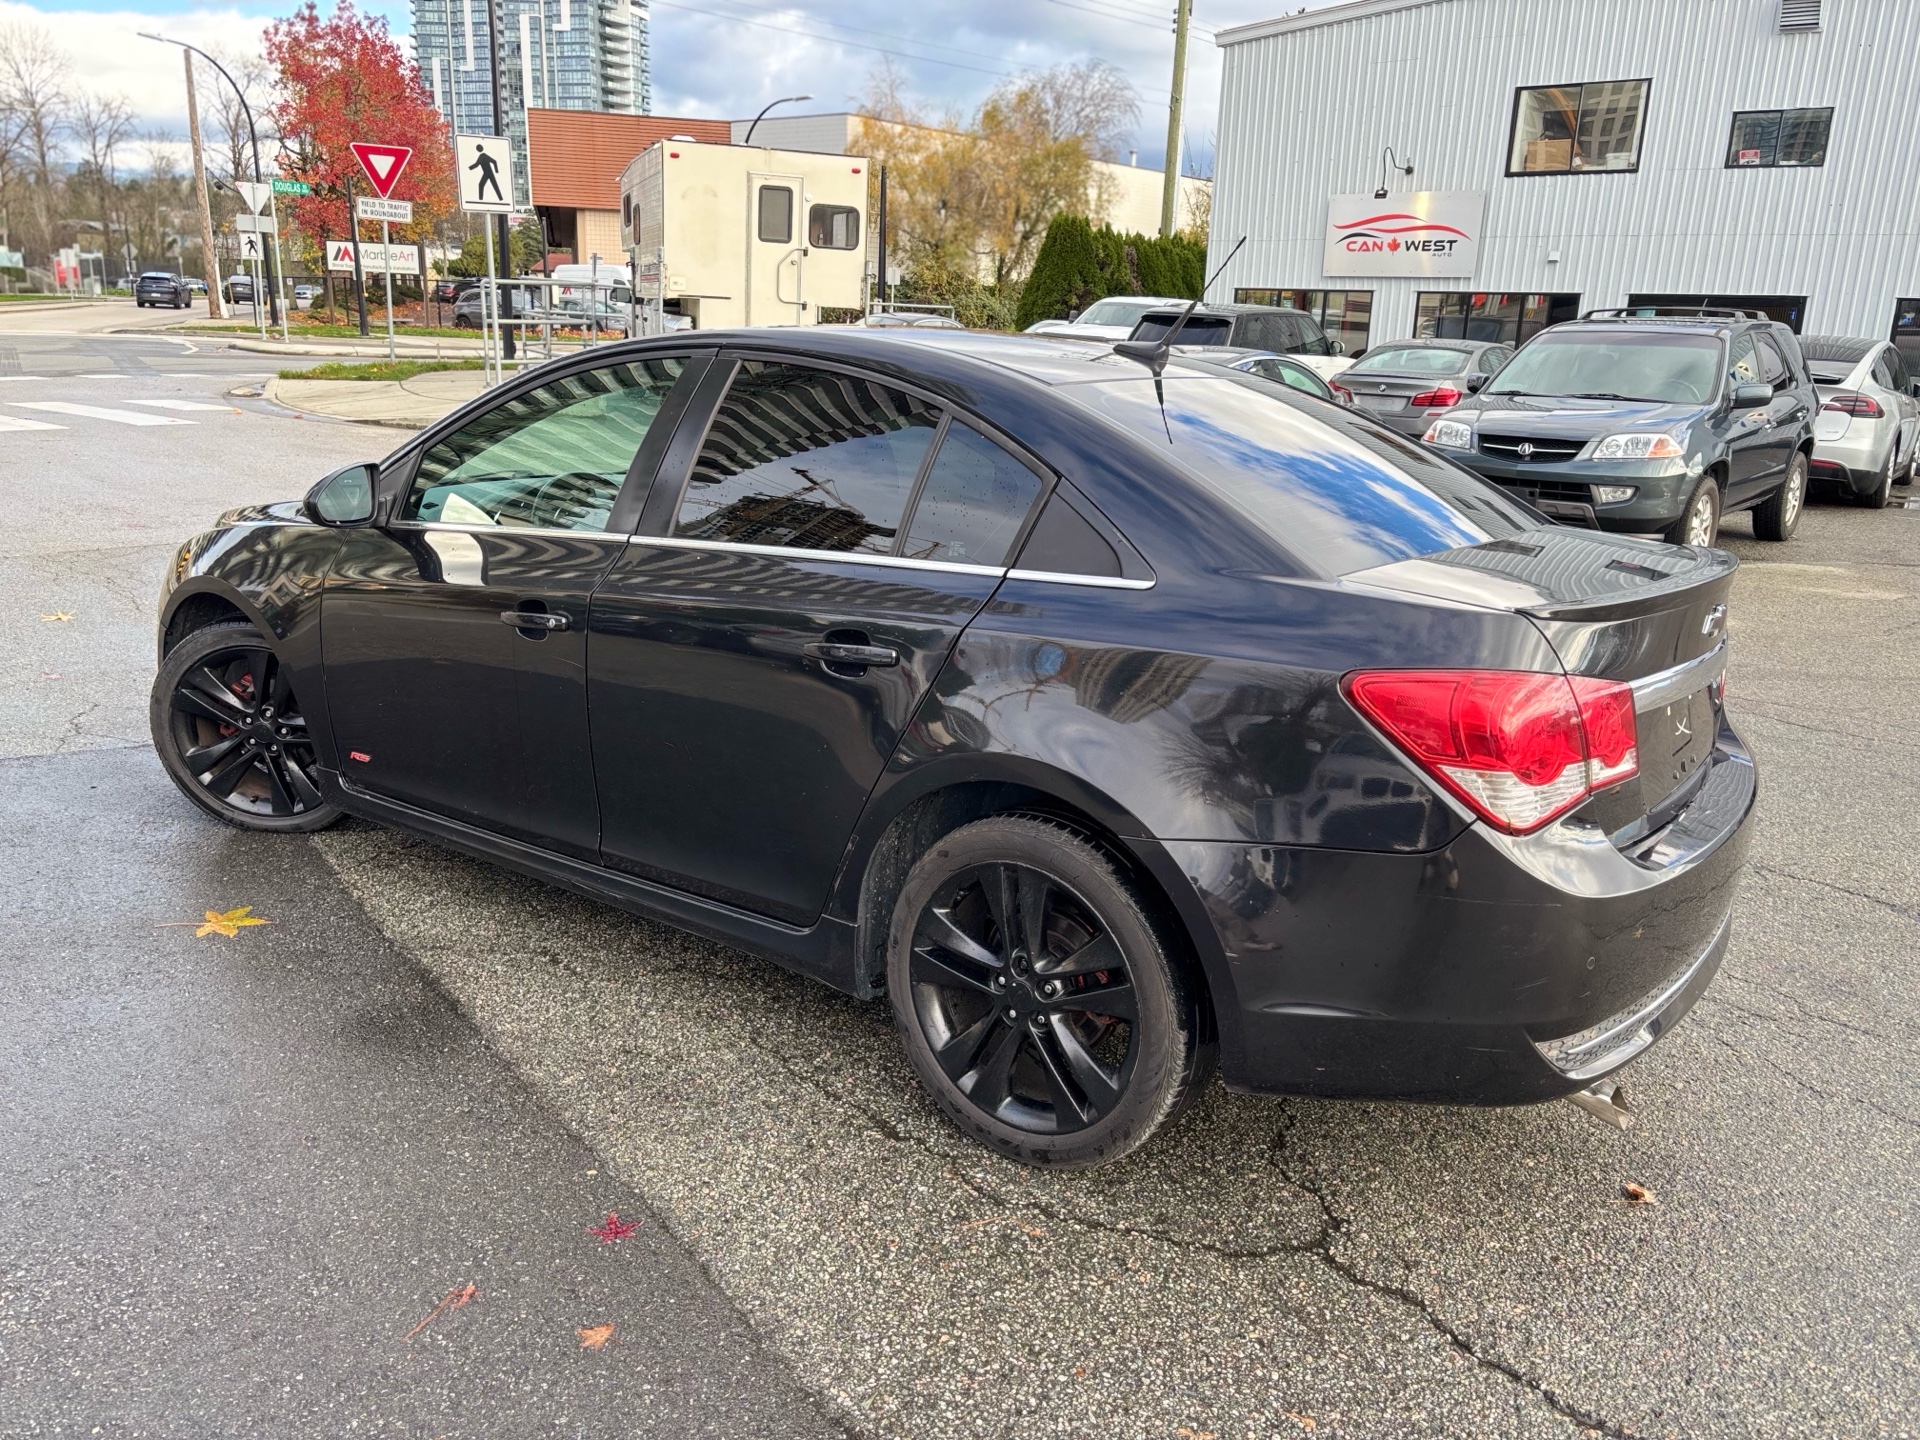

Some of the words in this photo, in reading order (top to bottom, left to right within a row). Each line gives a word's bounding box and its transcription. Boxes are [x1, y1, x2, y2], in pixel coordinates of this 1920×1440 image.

[274, 181, 301, 192] DOUGLAS
[360, 200, 376, 208] YIELD
[387, 203, 408, 212] TRAFFIC
[370, 209, 408, 219] ROUNDABOUT
[1346, 240, 1384, 252] CAN
[1405, 239, 1458, 252] WEST
[359, 249, 415, 262] MarbeArt
[350, 751, 371, 763] RS
